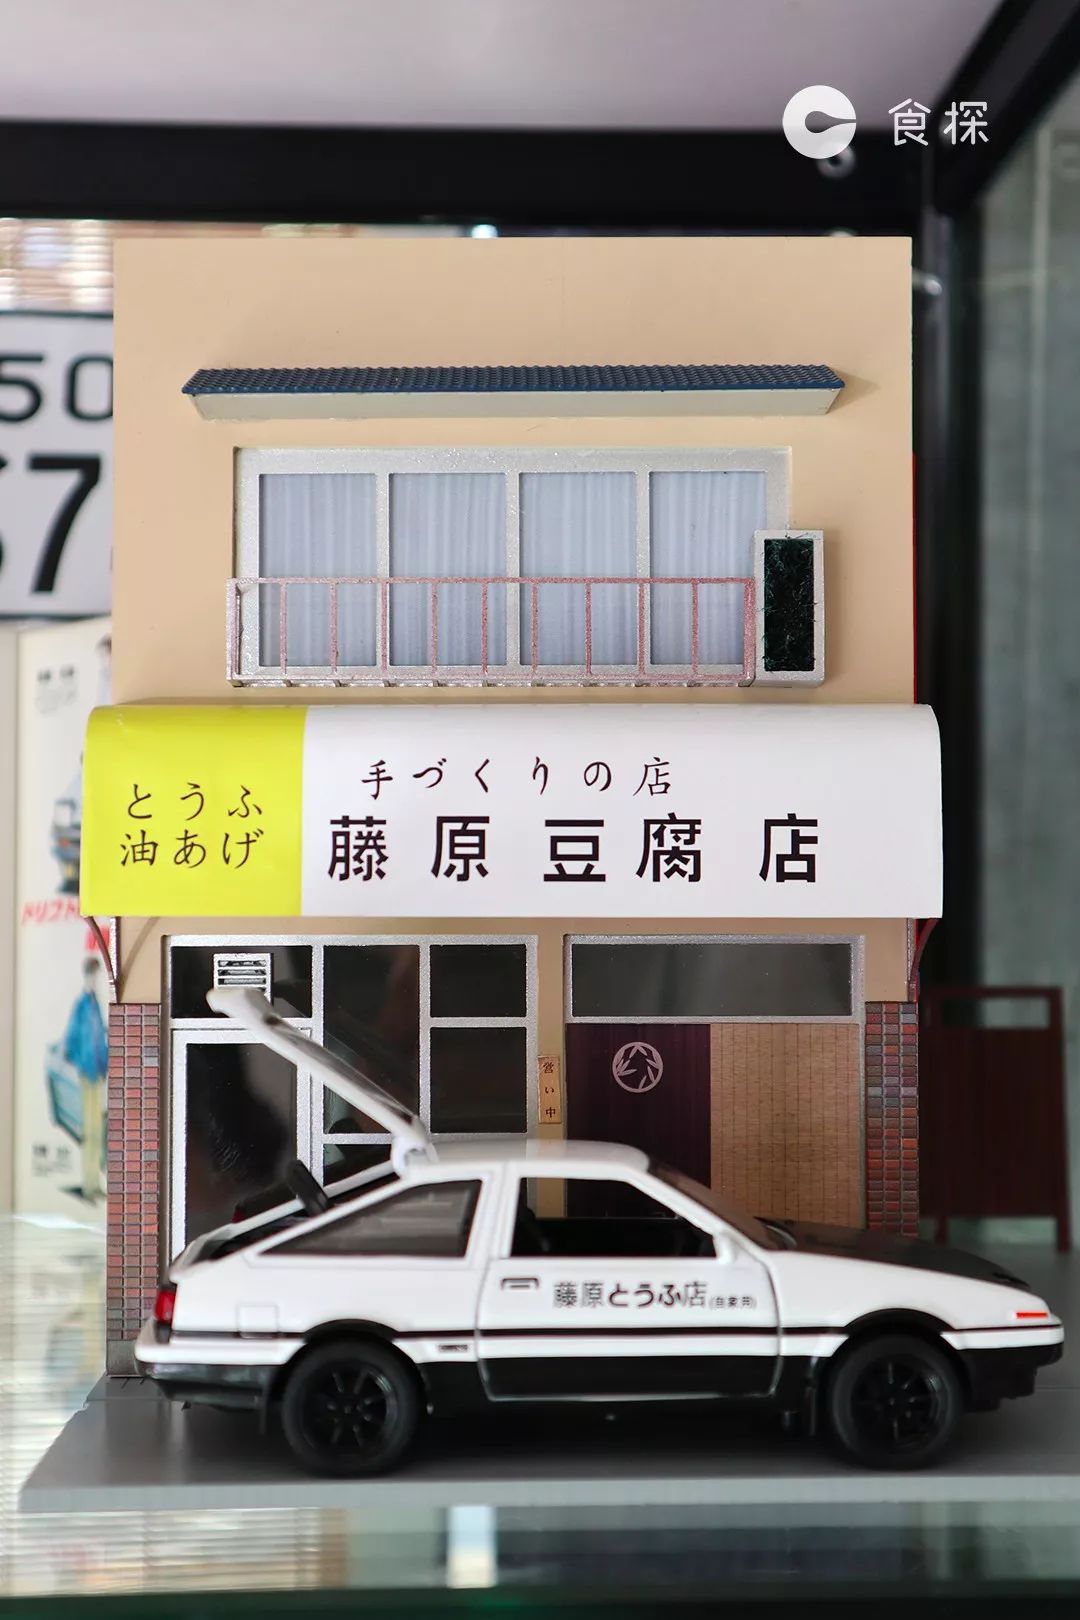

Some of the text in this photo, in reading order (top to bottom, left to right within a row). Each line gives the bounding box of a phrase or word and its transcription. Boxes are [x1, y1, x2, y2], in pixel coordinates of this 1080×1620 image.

[361, 756, 672, 800] 手づくりの店
[126, 782, 263, 821] とうふ
[120, 828, 264, 869] 油あげ
[327, 812, 819, 883] 藤原豆腐店
